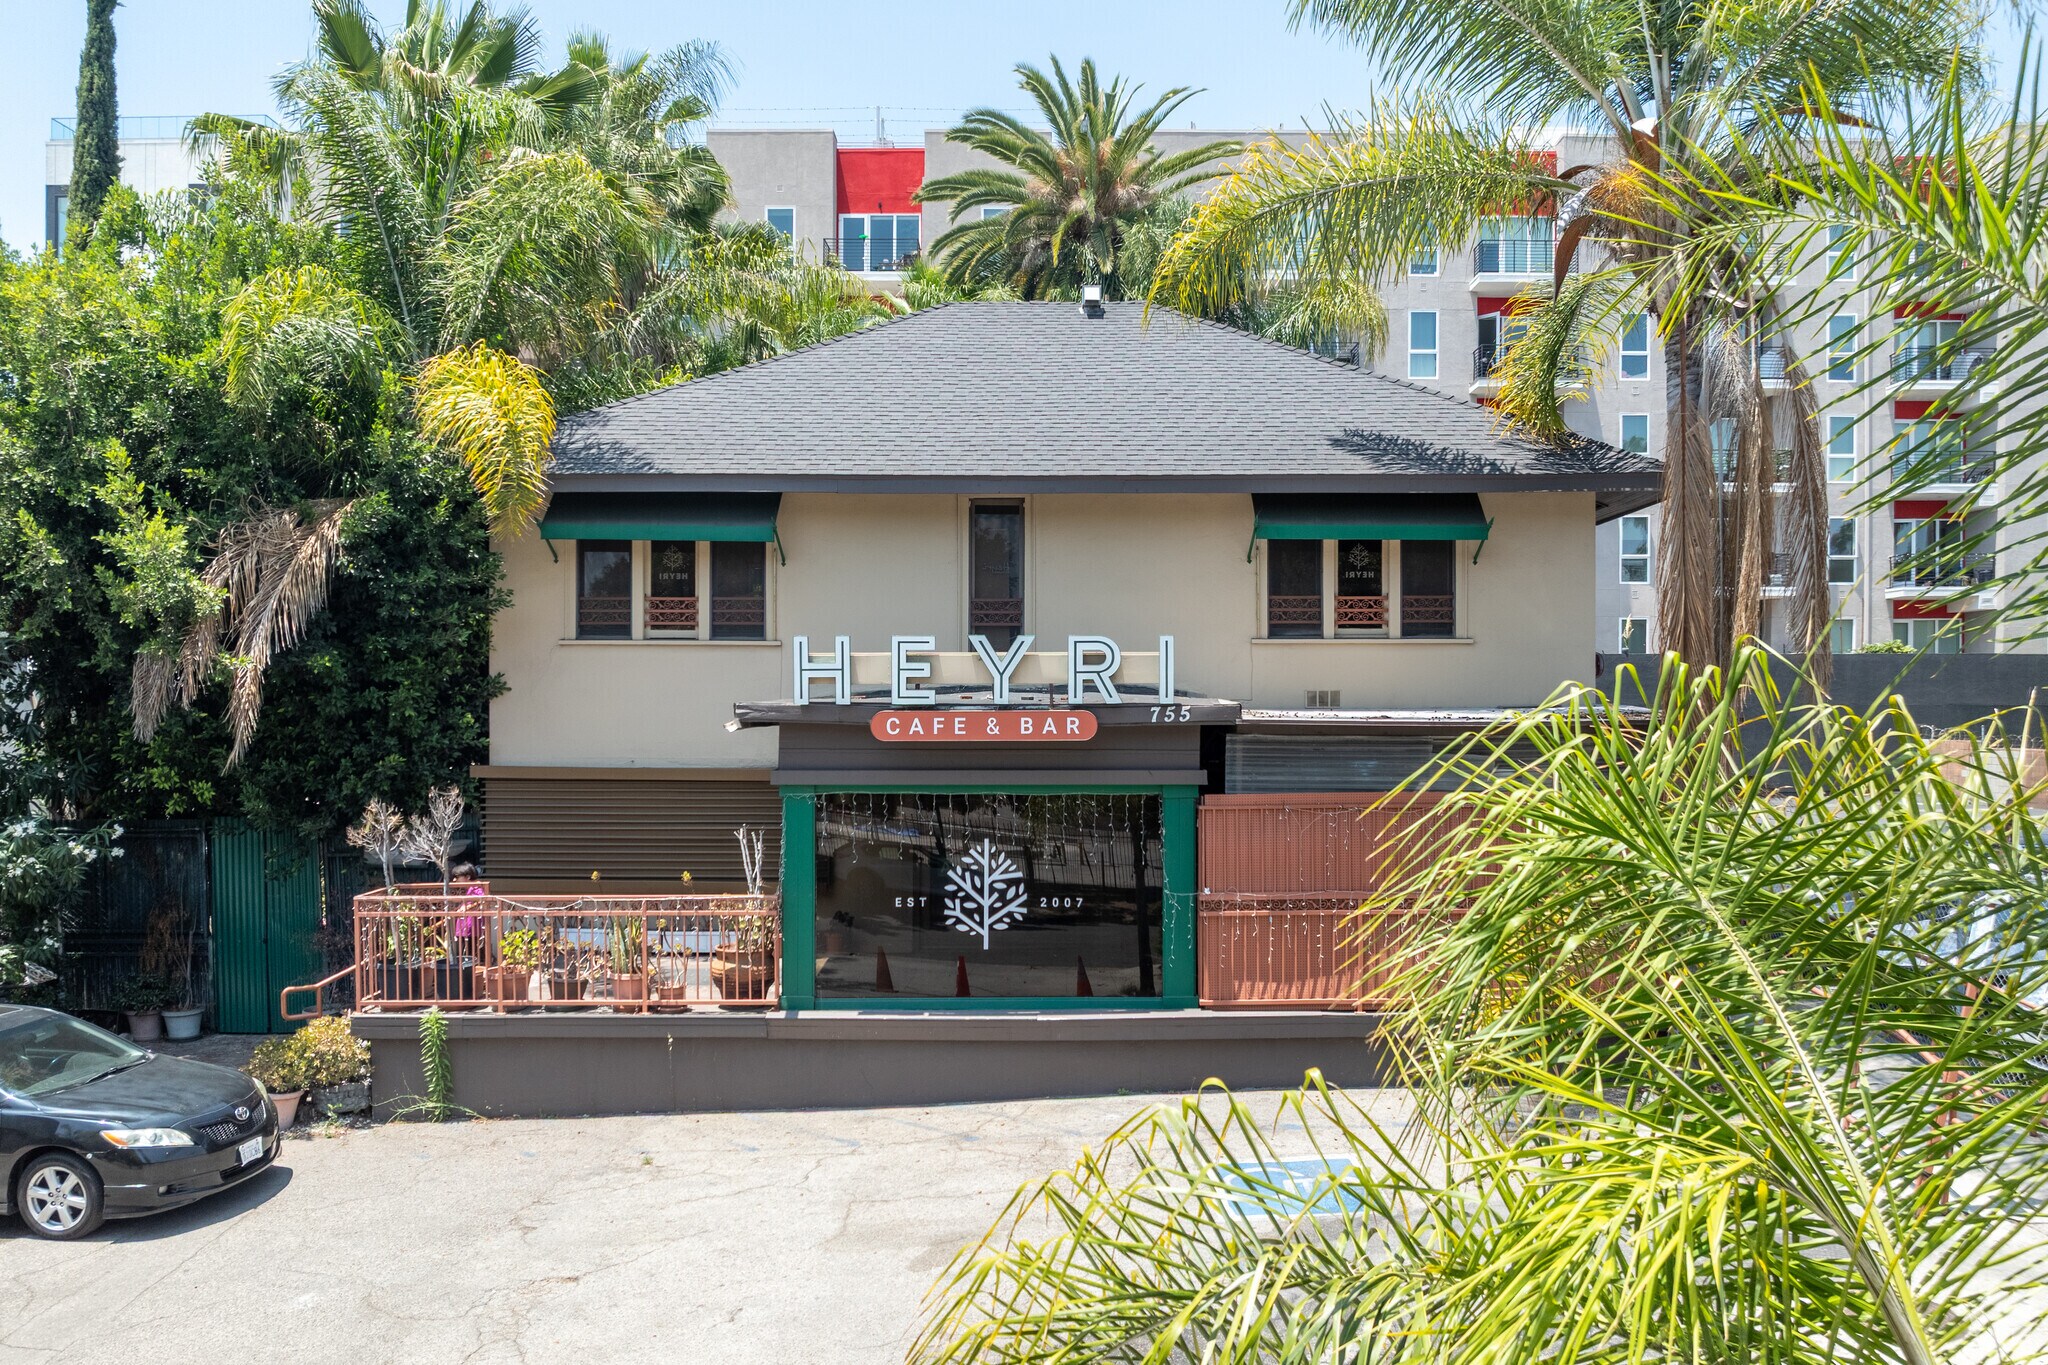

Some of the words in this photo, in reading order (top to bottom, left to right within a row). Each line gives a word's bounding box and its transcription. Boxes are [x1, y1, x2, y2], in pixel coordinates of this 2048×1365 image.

[793, 634, 1175, 705] HEYRI
[1150, 705, 1192, 723] 755
[886, 717, 967, 736] CAFE
[986, 717, 1001, 735] &
[1020, 716, 1081, 735] BAR
[895, 897, 927, 908] EST
[1040, 897, 1084, 908] 2007
